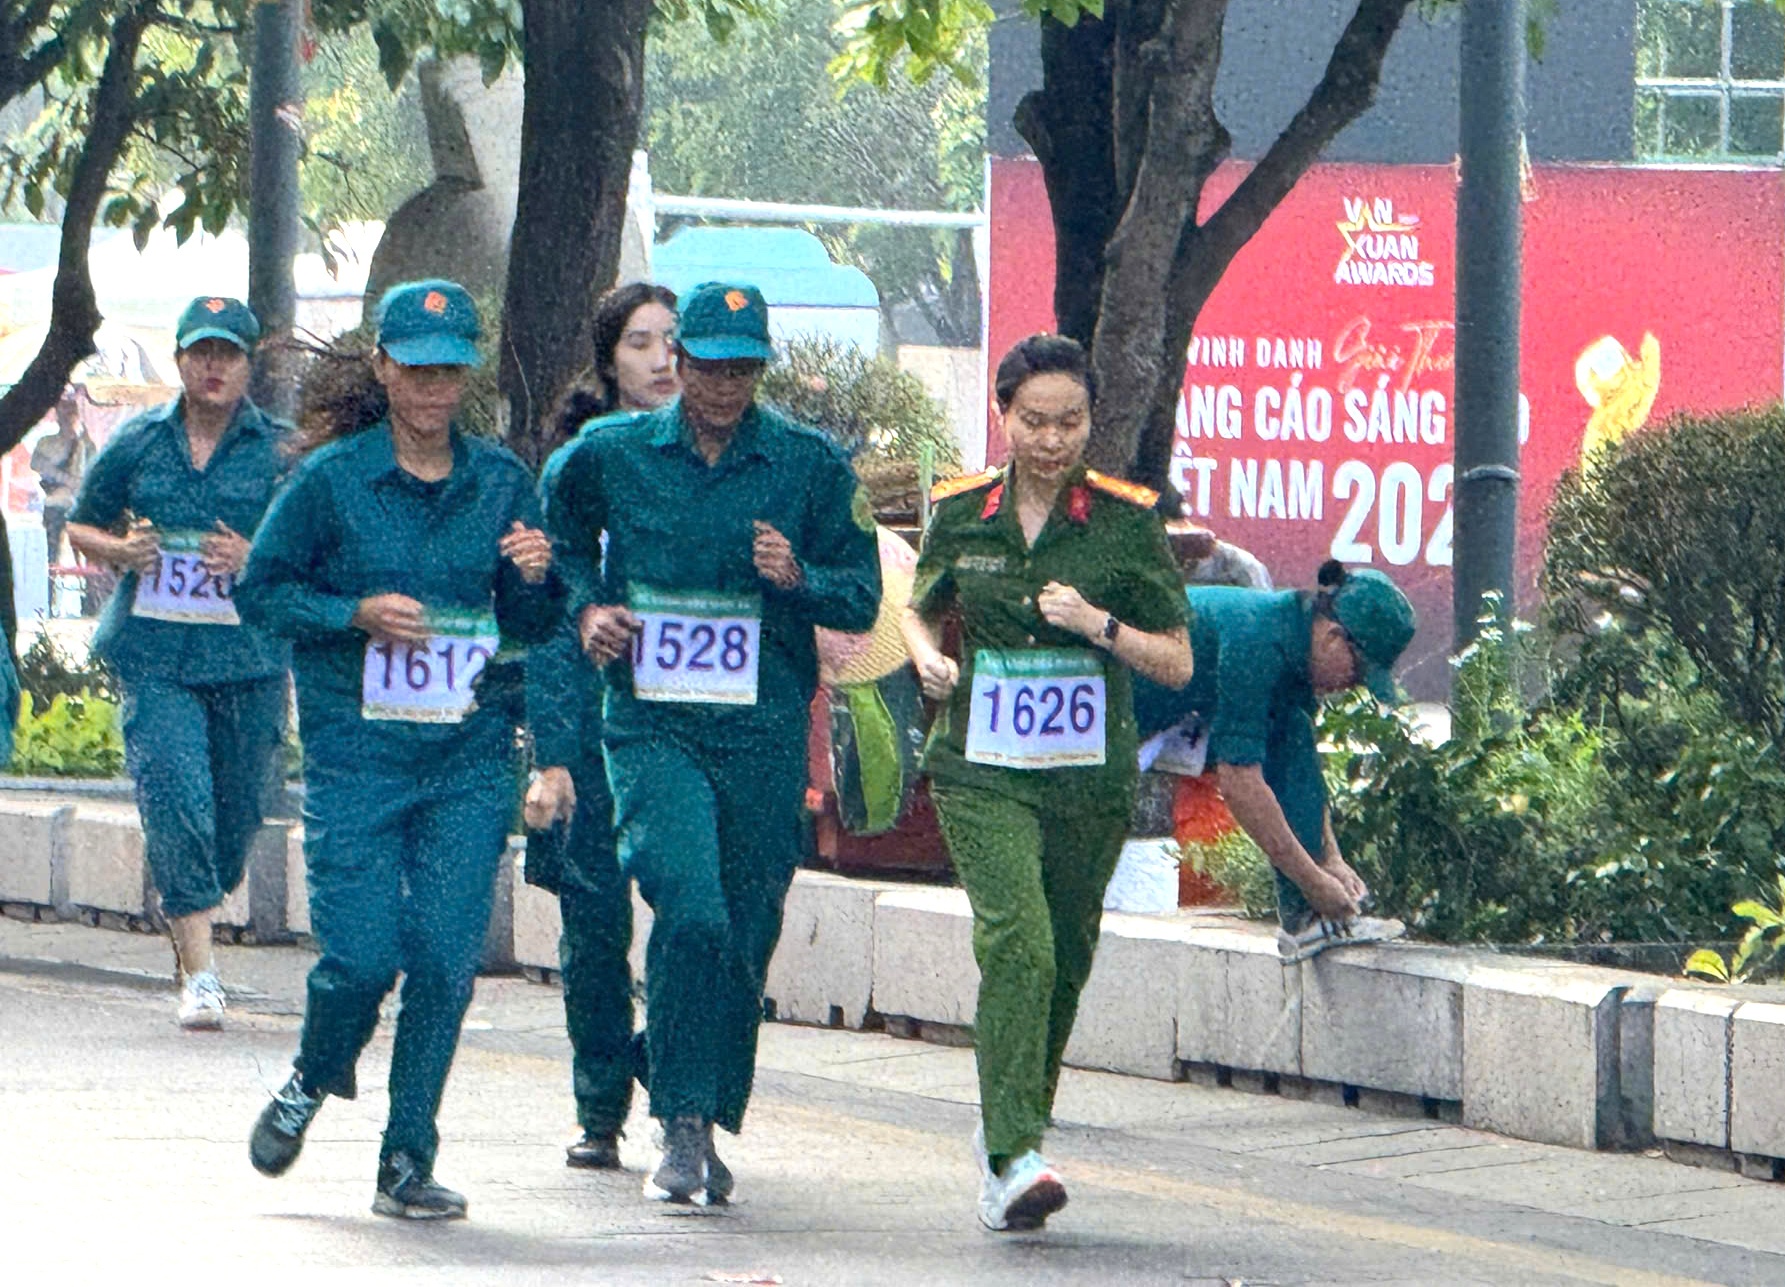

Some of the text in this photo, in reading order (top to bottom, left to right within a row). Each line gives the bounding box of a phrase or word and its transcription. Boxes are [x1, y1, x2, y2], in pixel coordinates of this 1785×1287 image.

[1333, 260, 1435, 287] AWARDS
[1187, 336, 1246, 368] VINH
[1256, 337, 1323, 370] DANH
[1254, 370, 1333, 442] CÁO
[1343, 373, 1447, 445] SÁNG
[1229, 457, 1325, 521] NAM
[1330, 459, 1455, 567] 202
[635, 620, 749, 673] 1528
[983, 683, 1096, 737] 1626
